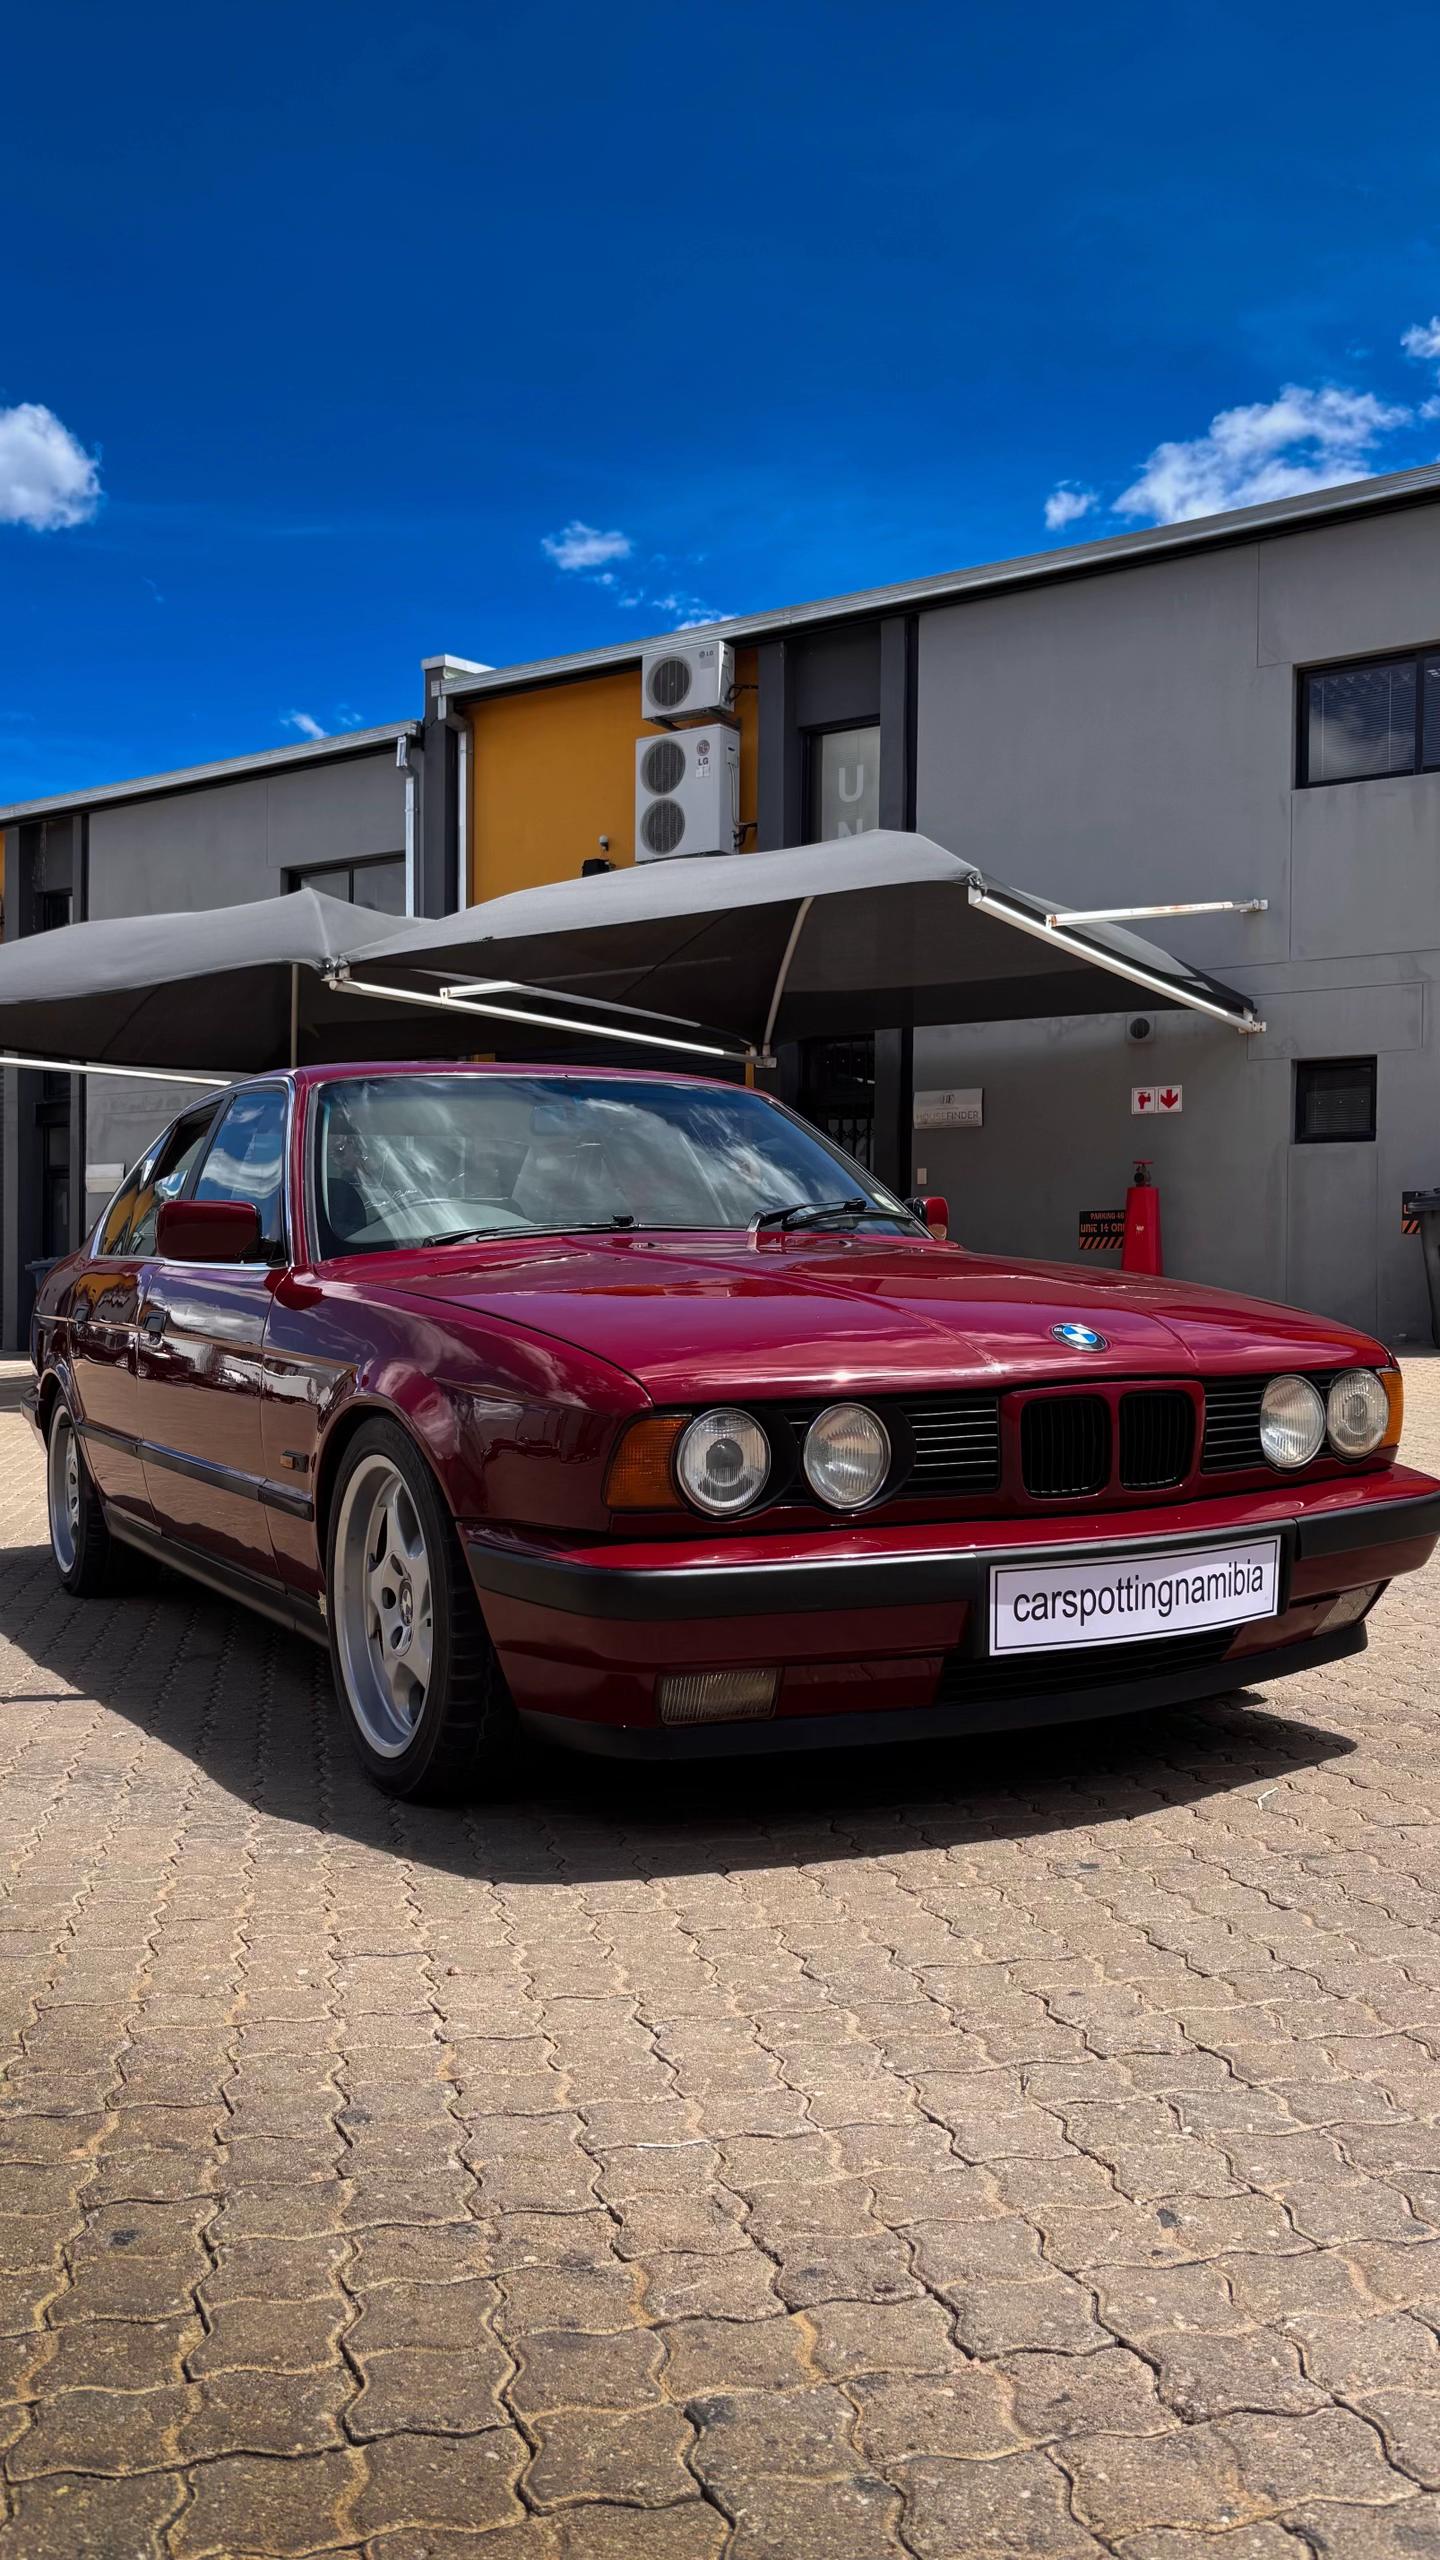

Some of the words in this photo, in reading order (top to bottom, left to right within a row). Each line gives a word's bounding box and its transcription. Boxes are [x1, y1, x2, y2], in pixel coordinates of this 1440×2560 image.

[698, 757, 709, 766] LG
[1090, 1212, 1116, 1220] PARKING
[1013, 1558, 1264, 1627] carspottingnamibia
